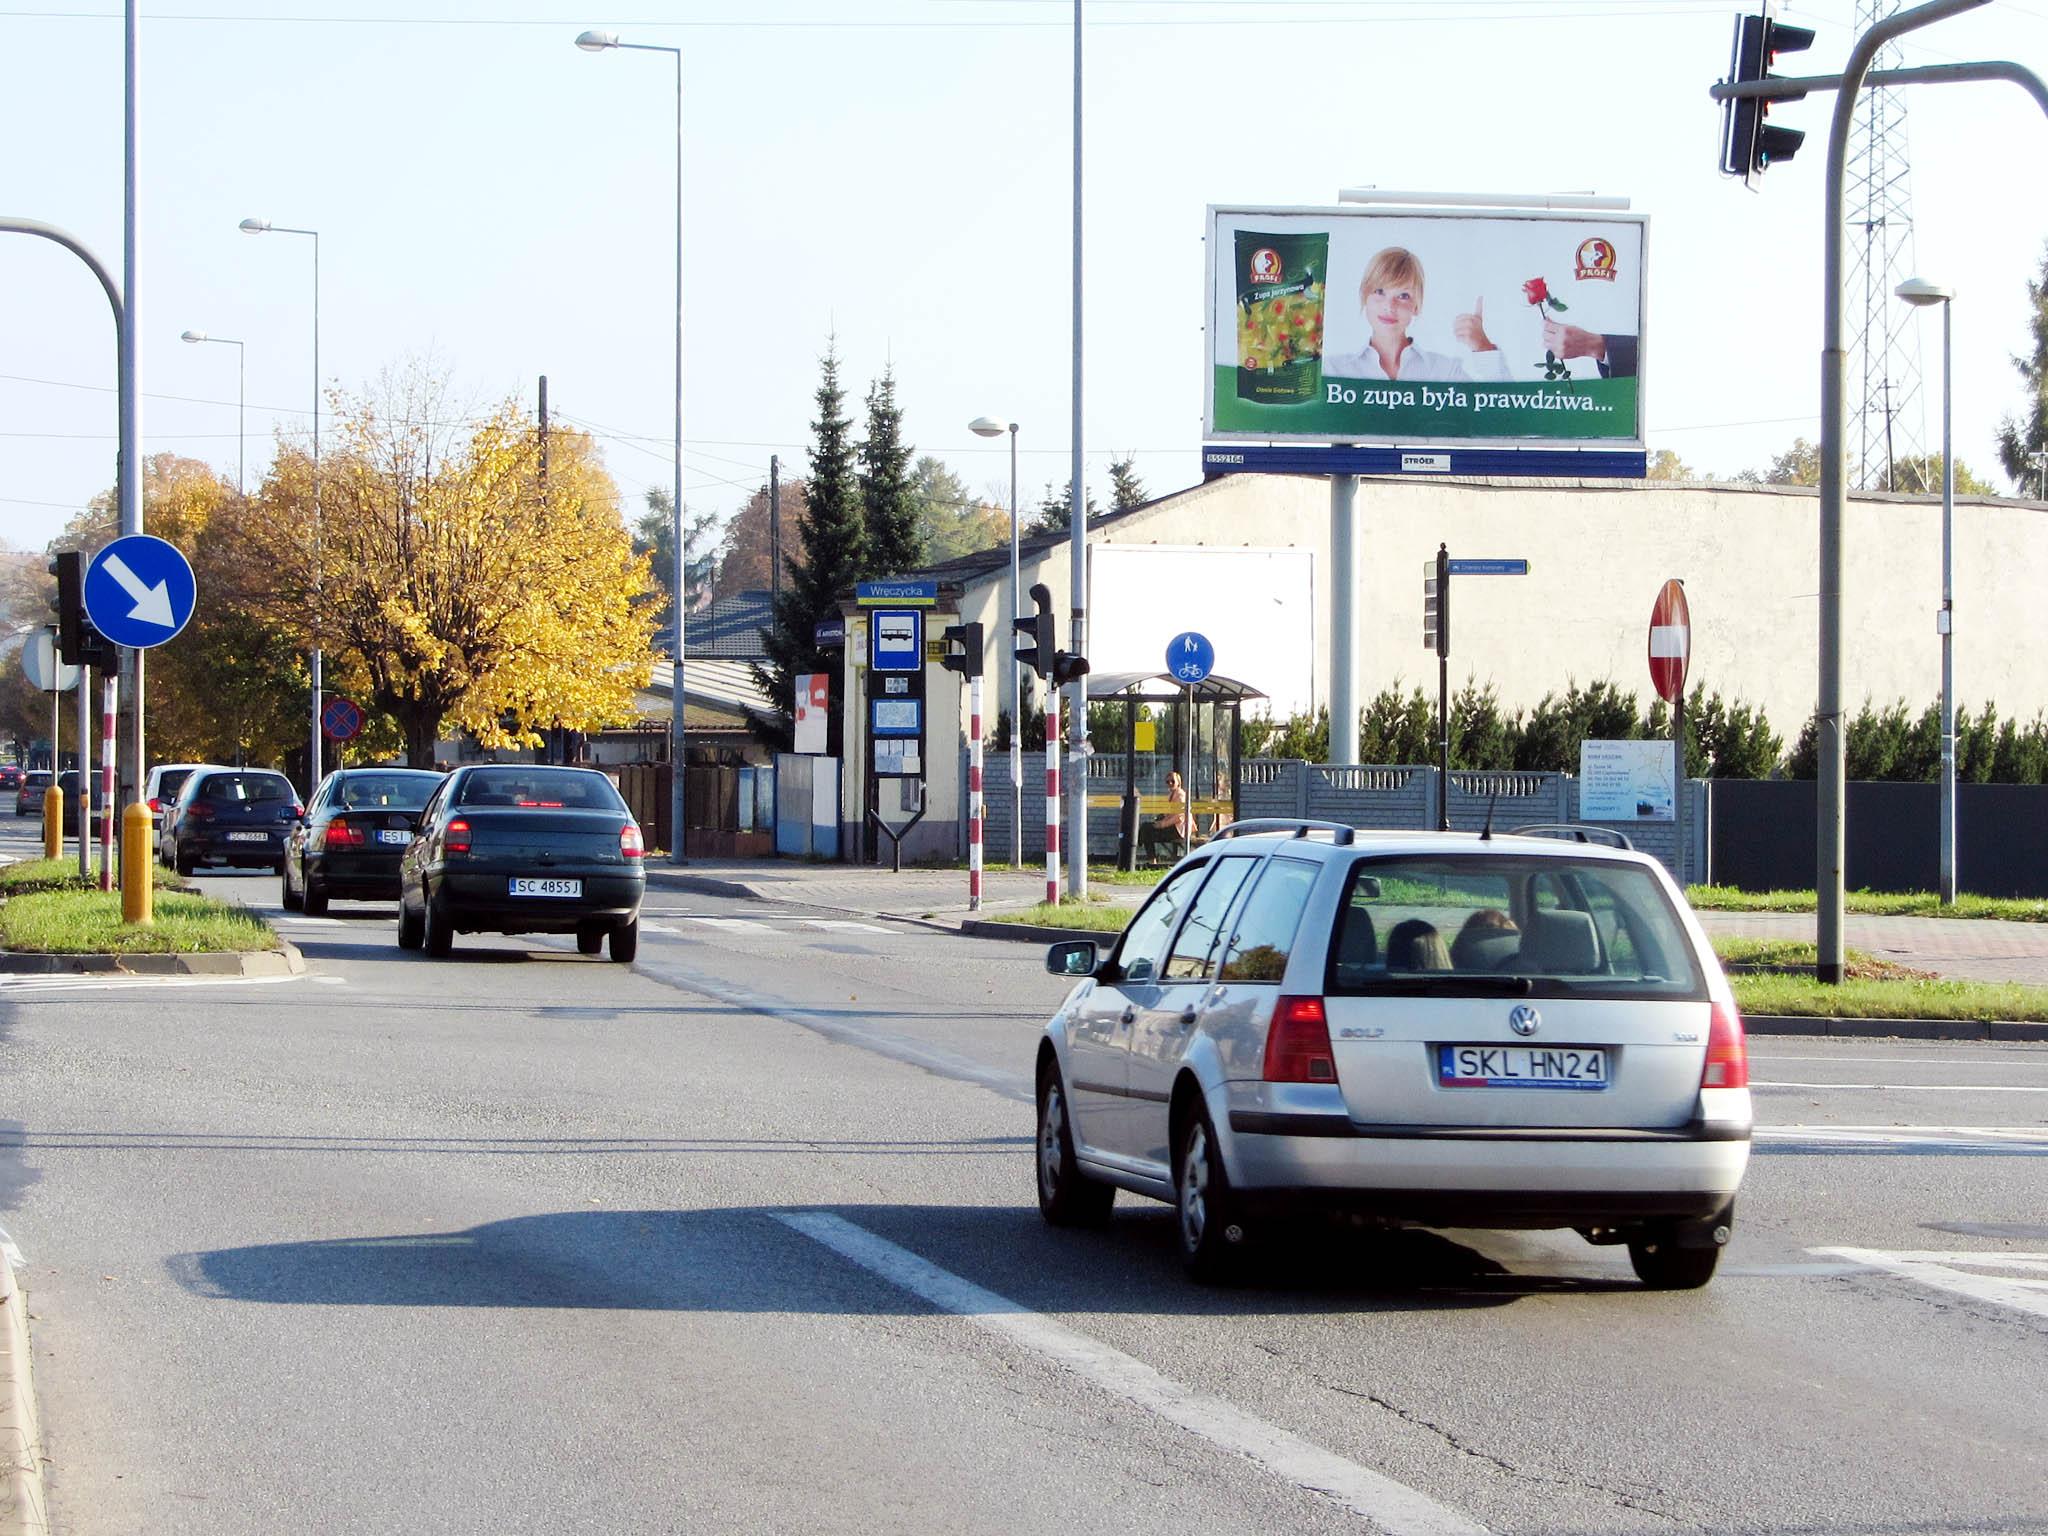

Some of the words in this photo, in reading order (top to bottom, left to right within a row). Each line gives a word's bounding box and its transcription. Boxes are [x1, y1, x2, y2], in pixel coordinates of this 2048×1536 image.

[1254, 290, 1270, 300] Zupa
[1326, 384, 1357, 404] Bo
[1363, 388, 1415, 410] zupa
[1421, 387, 1467, 411] była
[1473, 390, 1614, 412] prawdziwa...
[870, 585, 923, 597] Wręczycka
[518, 880, 536, 892] SC
[540, 881, 578, 894] 4855J
[1460, 1050, 1519, 1077] SKL
[1529, 1051, 1601, 1079] HN24
